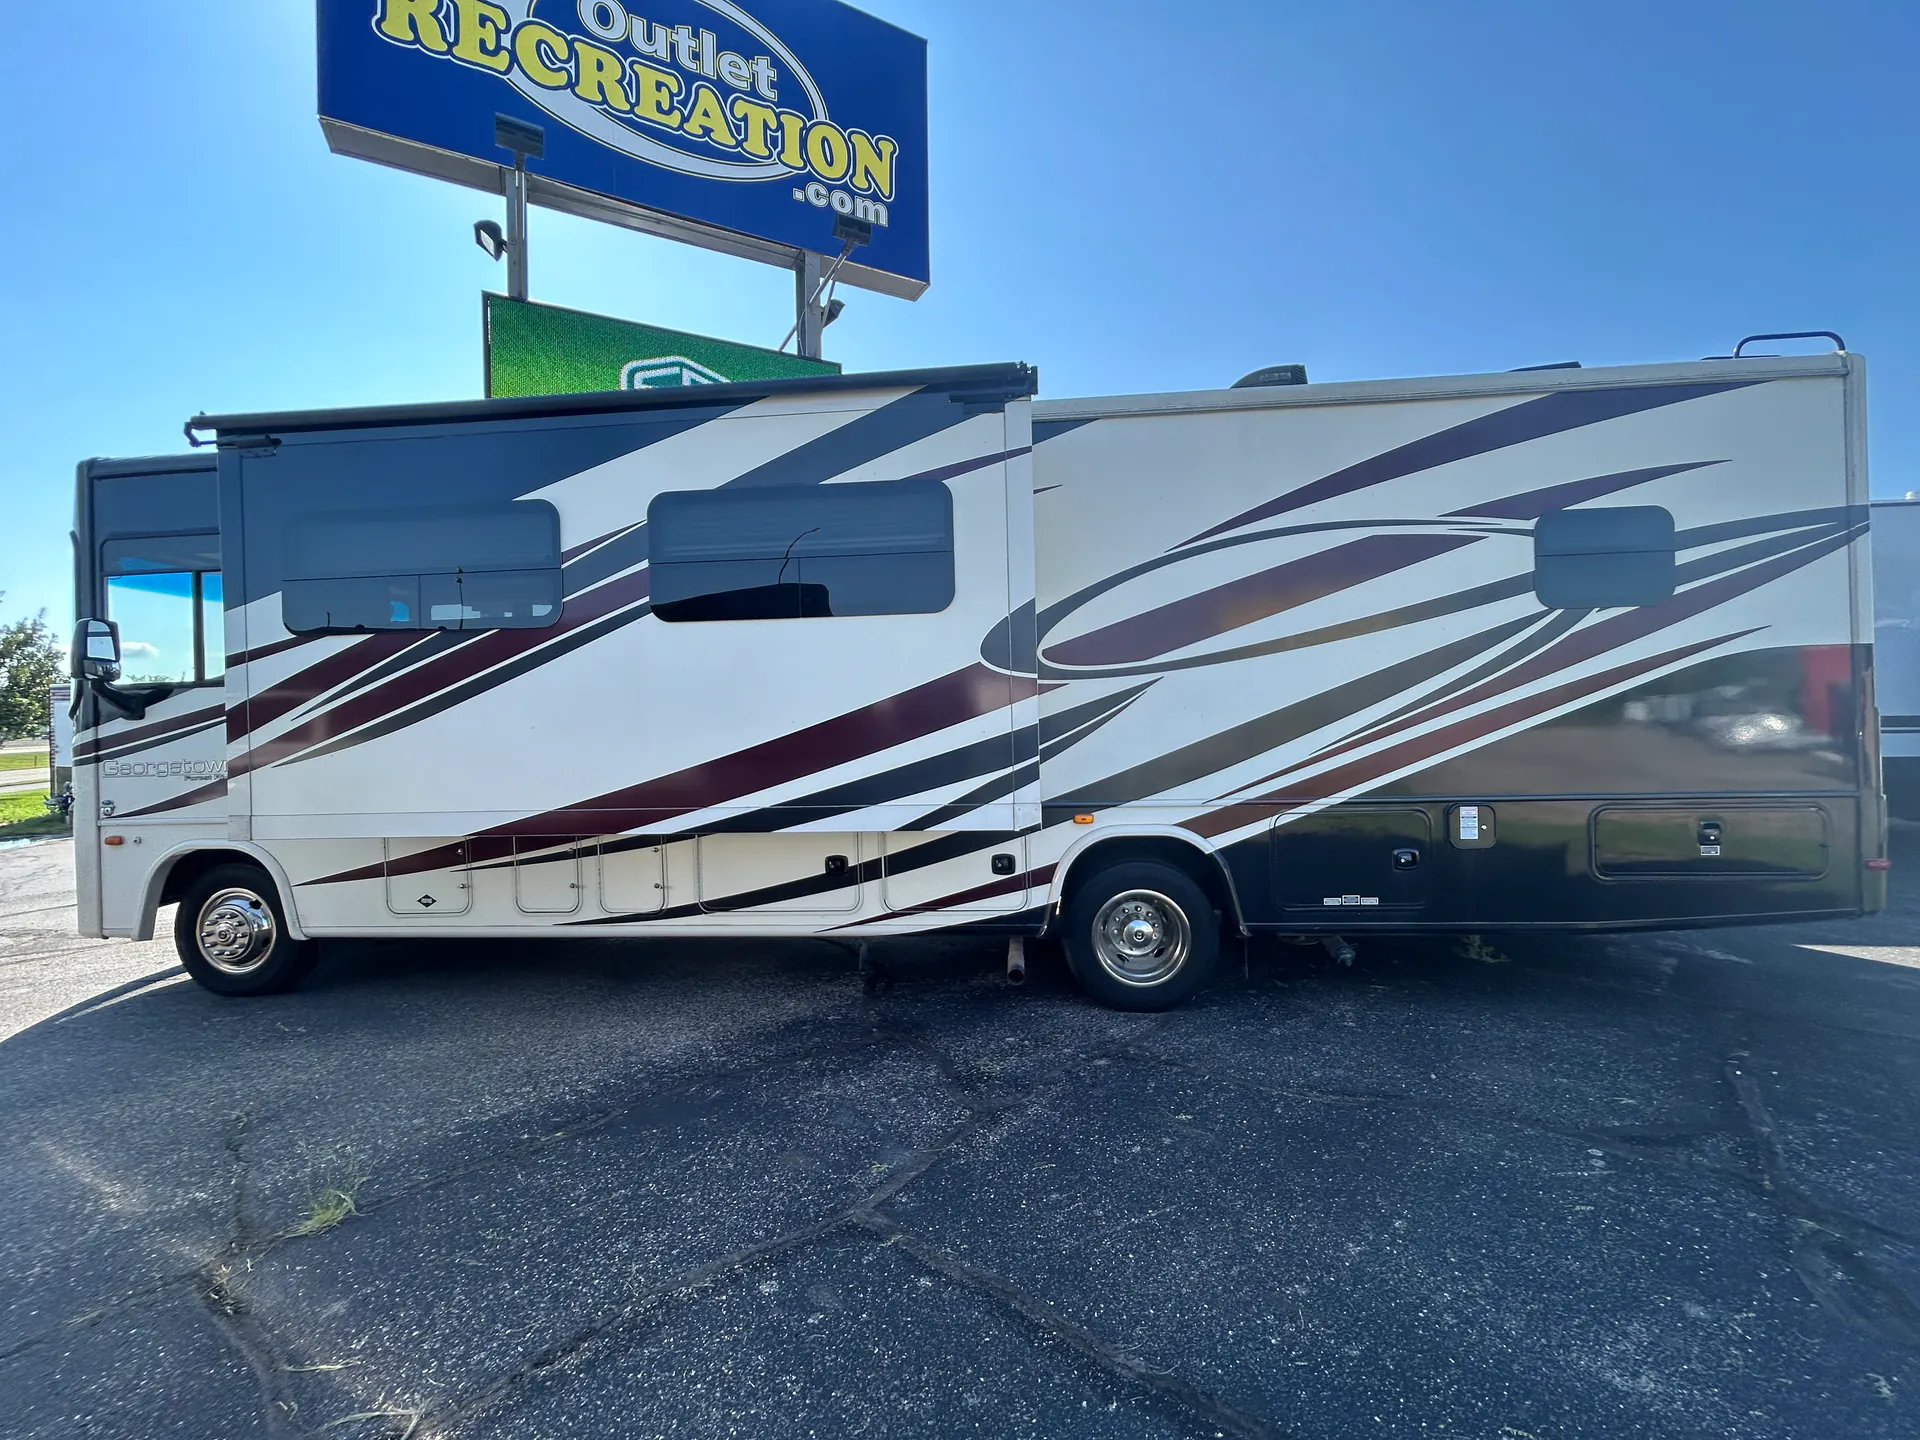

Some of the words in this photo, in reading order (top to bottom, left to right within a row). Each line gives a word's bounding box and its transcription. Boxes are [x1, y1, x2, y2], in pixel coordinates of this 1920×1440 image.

[373, 0, 898, 201] RECREATION
[576, 0, 779, 101] Outlet
[792, 181, 889, 227] .com
